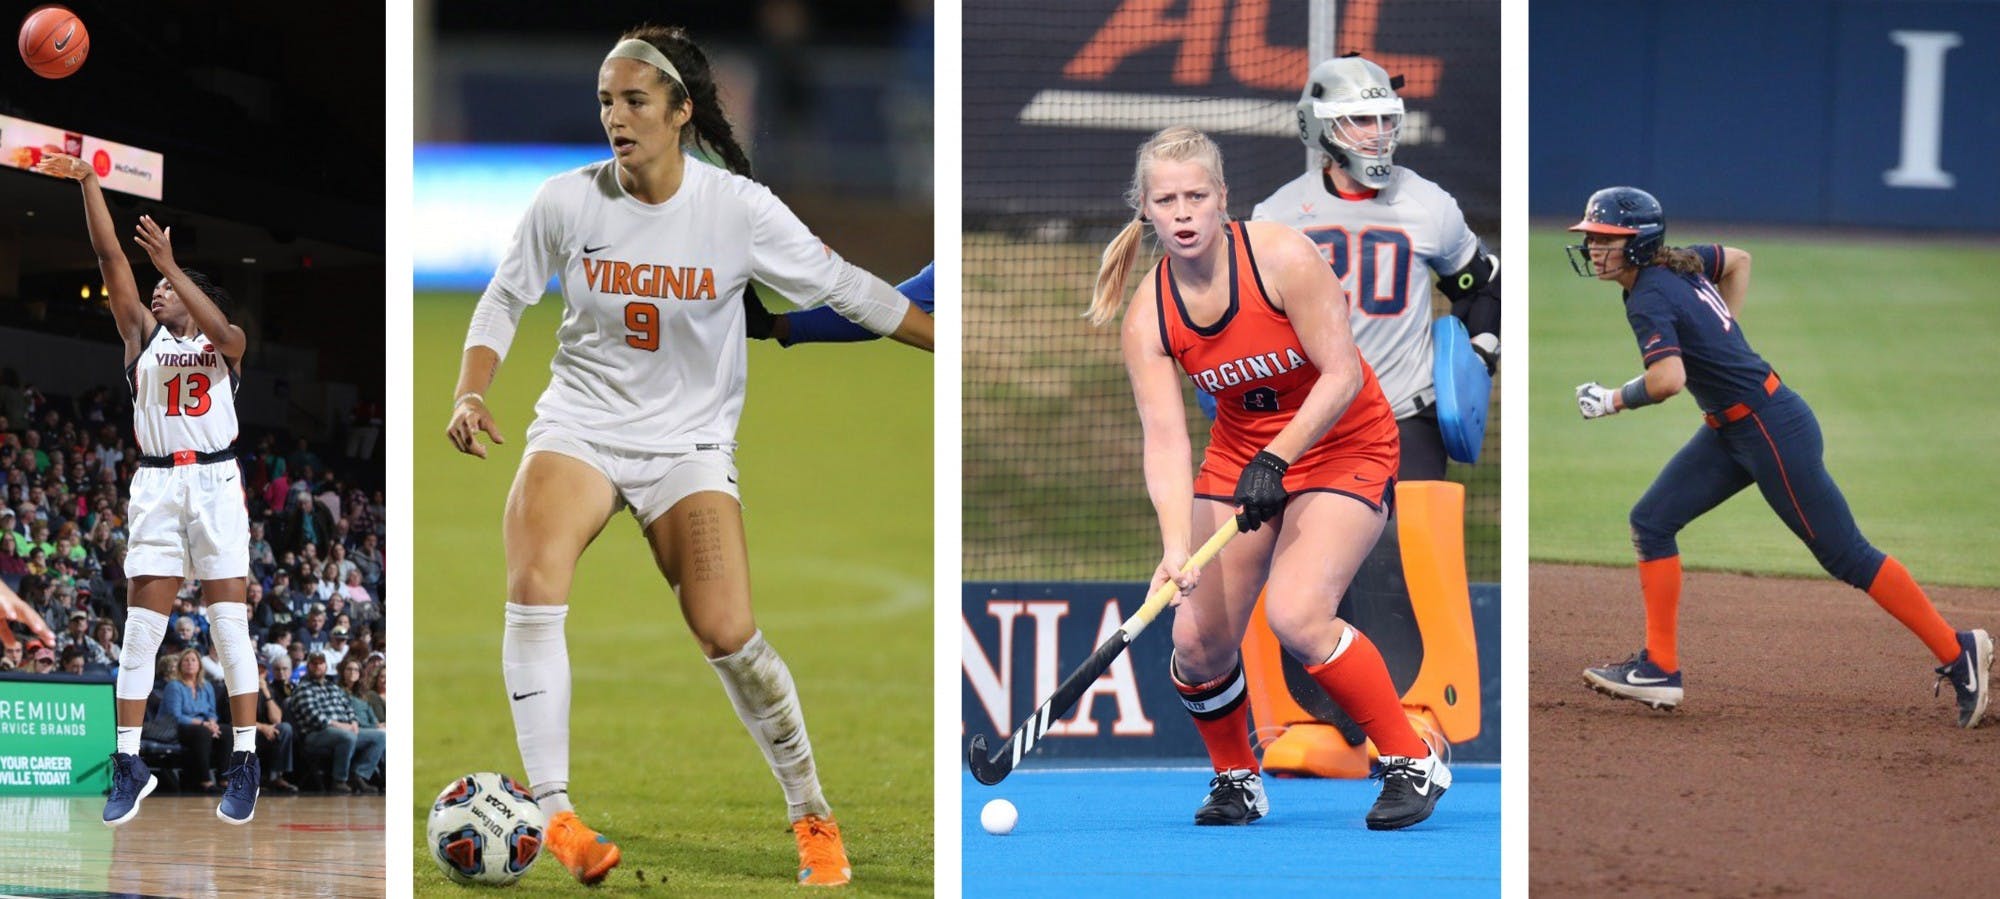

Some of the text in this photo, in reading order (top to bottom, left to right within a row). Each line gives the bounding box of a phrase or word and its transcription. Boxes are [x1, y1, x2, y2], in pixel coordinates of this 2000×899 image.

[1882, 30, 1964, 189] I
[582, 257, 717, 300] VIRGINIA
[624, 301, 660, 352] 9
[156, 353, 218, 369] VIRGINIA
[164, 372, 212, 417] 13
[40, 723, 87, 736] BRANDS
[1, 756, 72, 771] YOUR CAREER
[33, 771, 71, 786] TODAY!
[485, 794, 515, 819] NCAA
